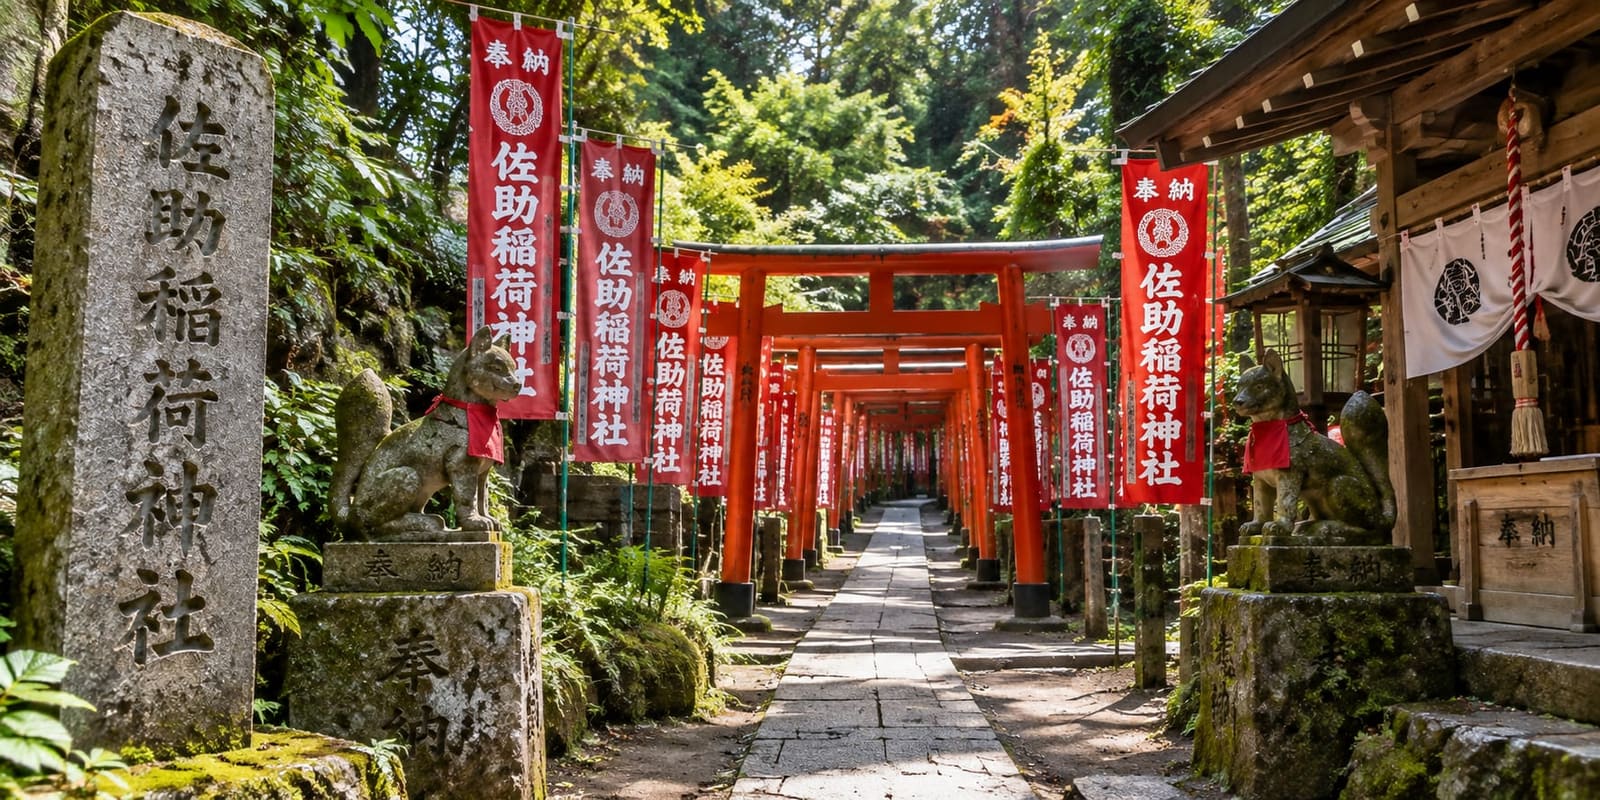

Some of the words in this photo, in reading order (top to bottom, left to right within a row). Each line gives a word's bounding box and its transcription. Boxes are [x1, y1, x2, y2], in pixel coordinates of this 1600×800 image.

[484, 39, 549, 76] 奉納
[591, 157, 645, 187] 奉納
[1134, 177, 1194, 203] 奉納
[116, 95, 229, 666] 佐助稲荷神社
[590, 241, 634, 446] 佐助稲荷神社
[652, 331, 686, 473] 佐助荷神社
[1138, 262, 1185, 487] 佐助稲荷神社
[698, 352, 726, 486] 佐助稲荷神社
[1069, 366, 1098, 499] 佐助稲荷神社
[363, 548, 464, 585] 奉納
[1497, 513, 1556, 547] 奉納
